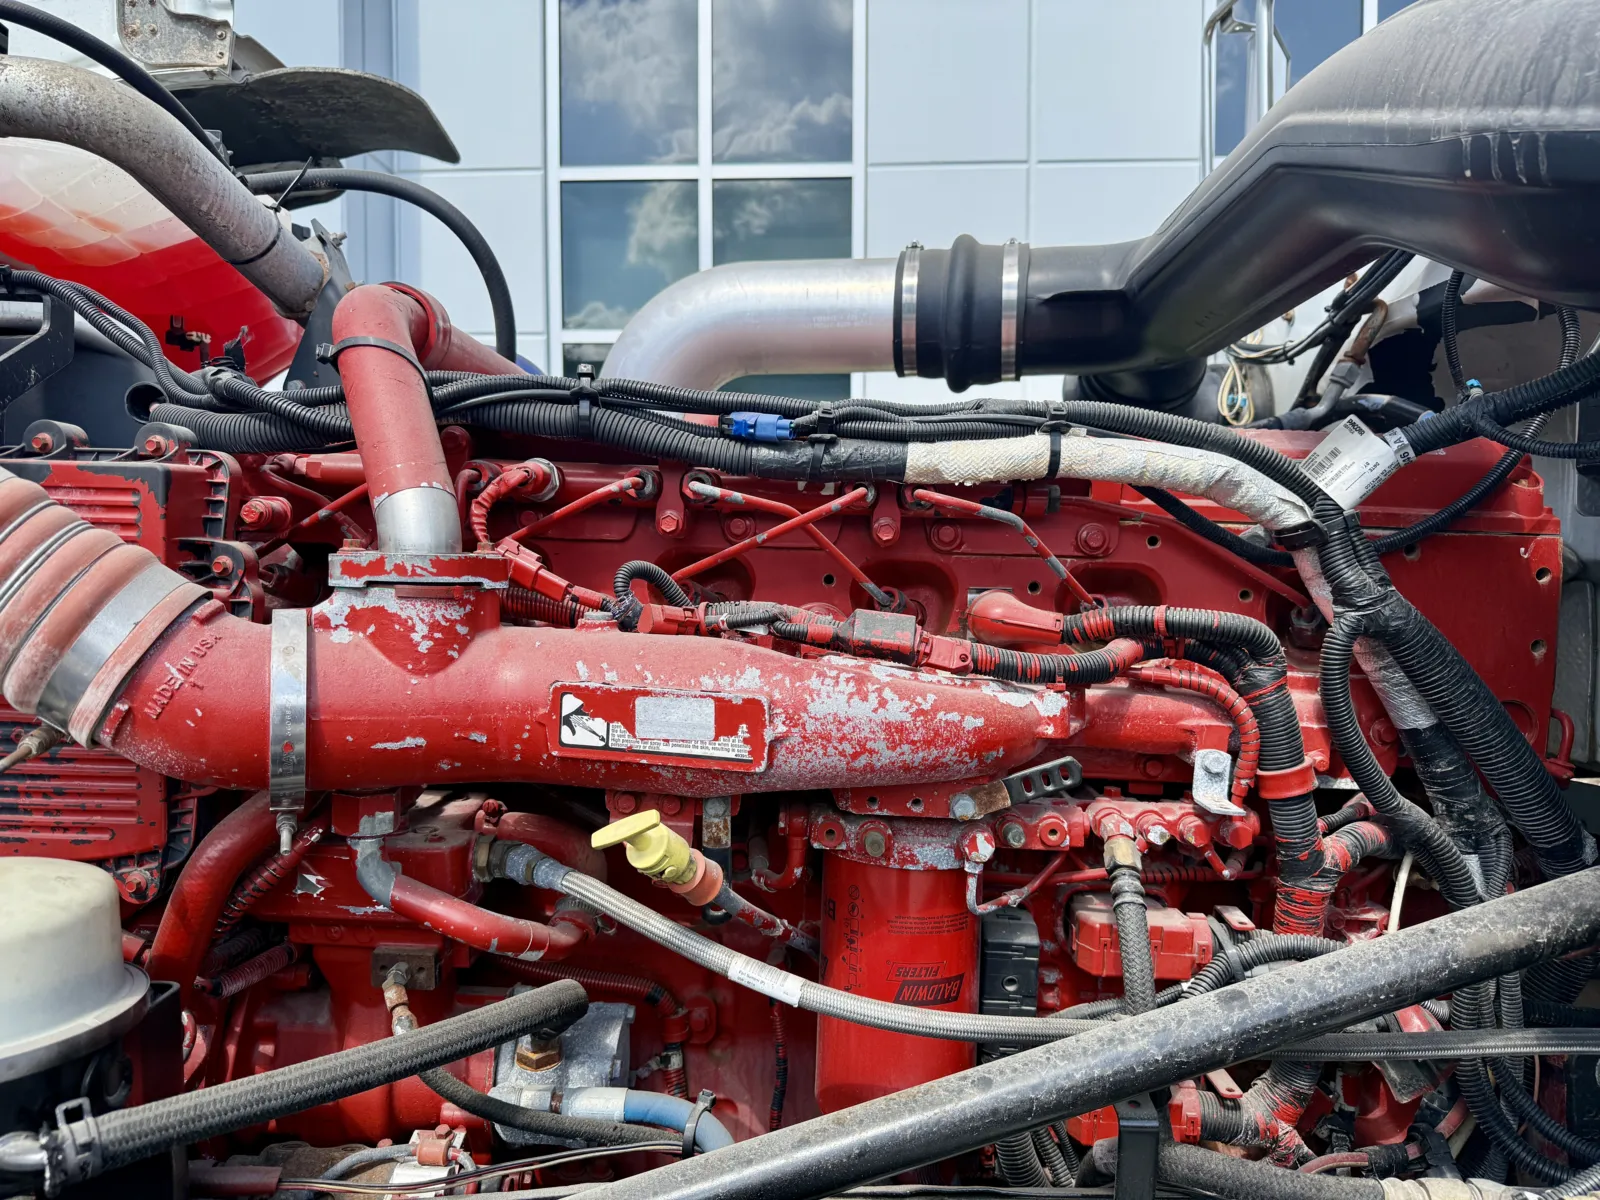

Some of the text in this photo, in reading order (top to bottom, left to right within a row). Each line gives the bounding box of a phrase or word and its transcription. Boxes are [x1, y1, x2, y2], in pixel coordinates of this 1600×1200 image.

[144, 675, 184, 720] MADE
[177, 656, 198, 677] IN
[894, 965, 940, 978] FILTERS
[900, 980, 960, 1001] BALDWIN
